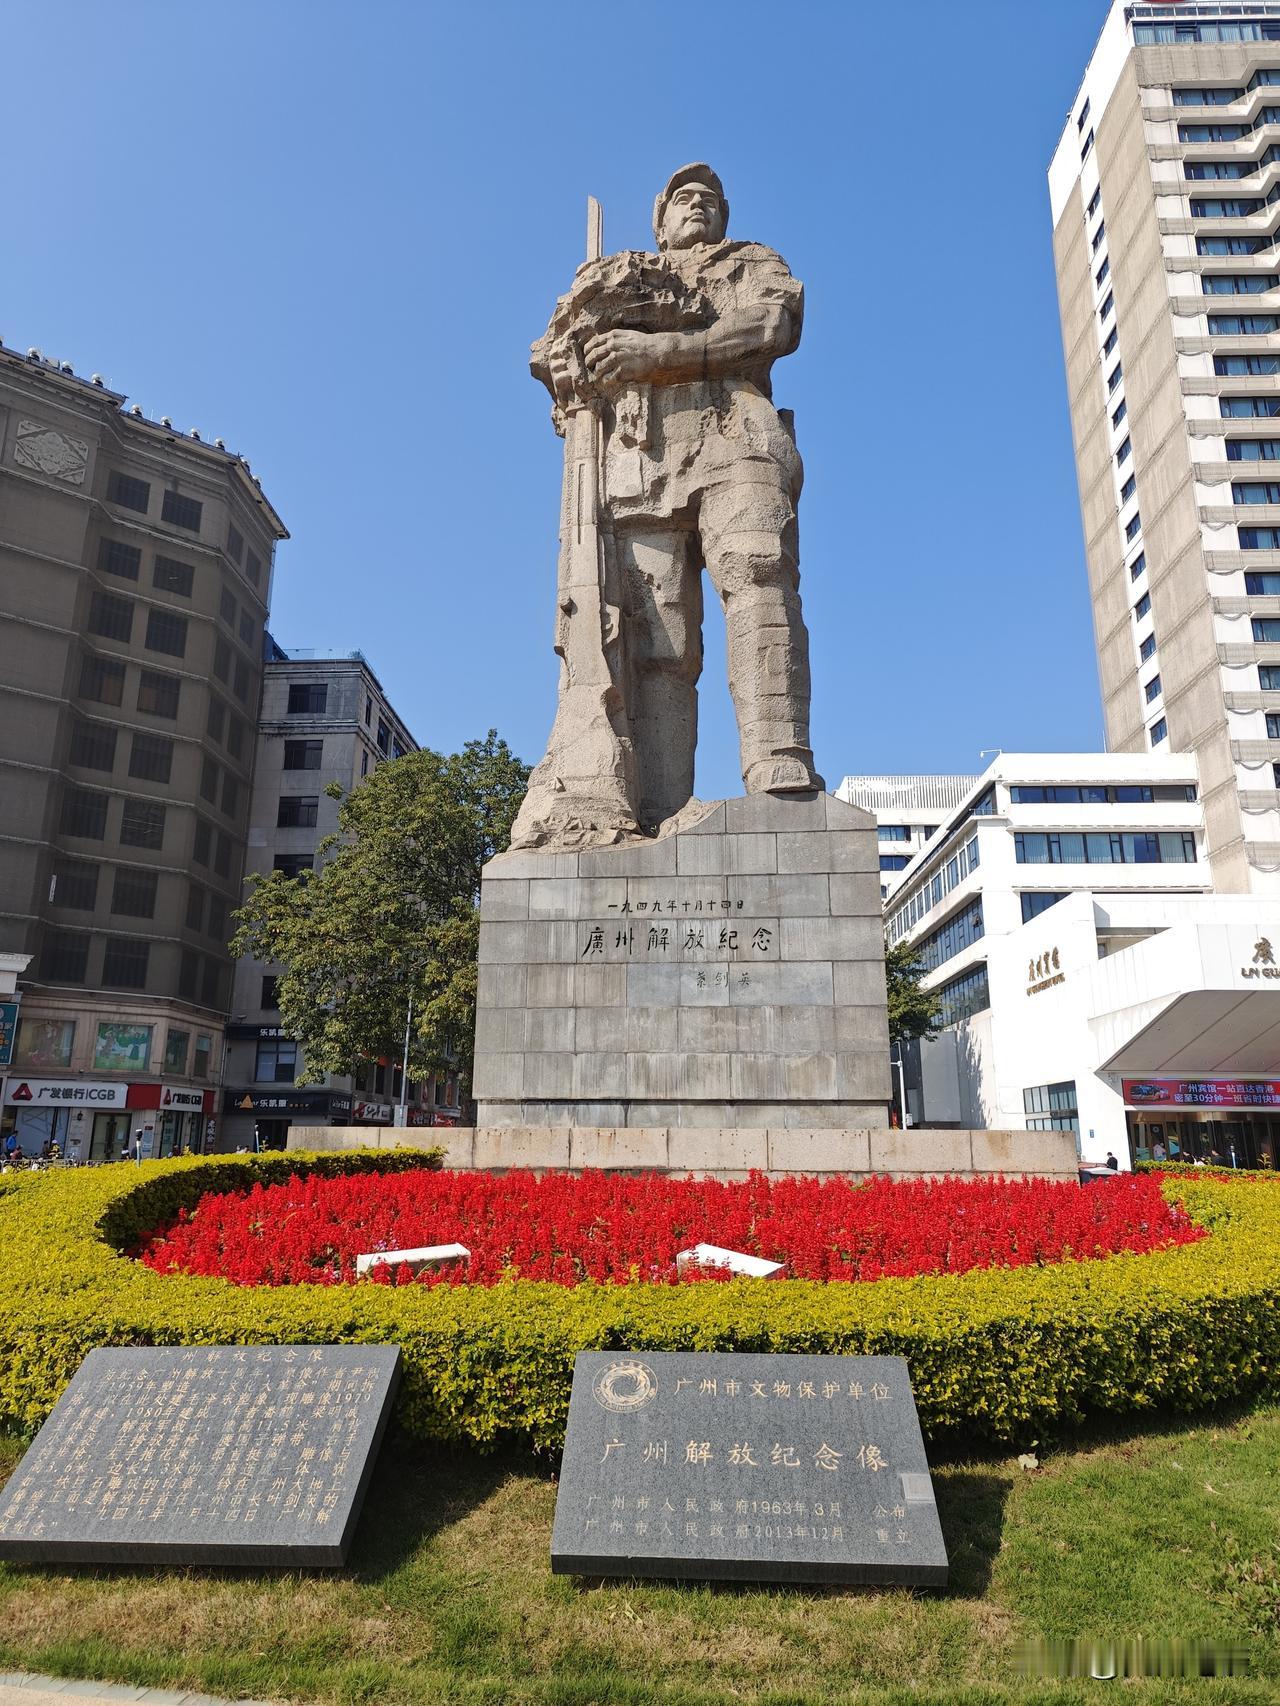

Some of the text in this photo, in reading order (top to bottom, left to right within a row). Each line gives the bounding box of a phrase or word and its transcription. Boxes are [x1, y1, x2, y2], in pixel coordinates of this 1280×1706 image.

[608, 899, 744, 913] 一九四九年十月十四日
[582, 927, 773, 958] 廣州解放紀念
[38, 1087, 116, 1100] 广发银行 CGB
[160, 1349, 324, 1363] 广州解放纪念像
[674, 1378, 893, 1400] 广州市文物保护单位
[600, 1439, 889, 1472] 广州解放纪念像
[873, 1503, 906, 1519] 公布
[875, 1526, 912, 1544] 重立
